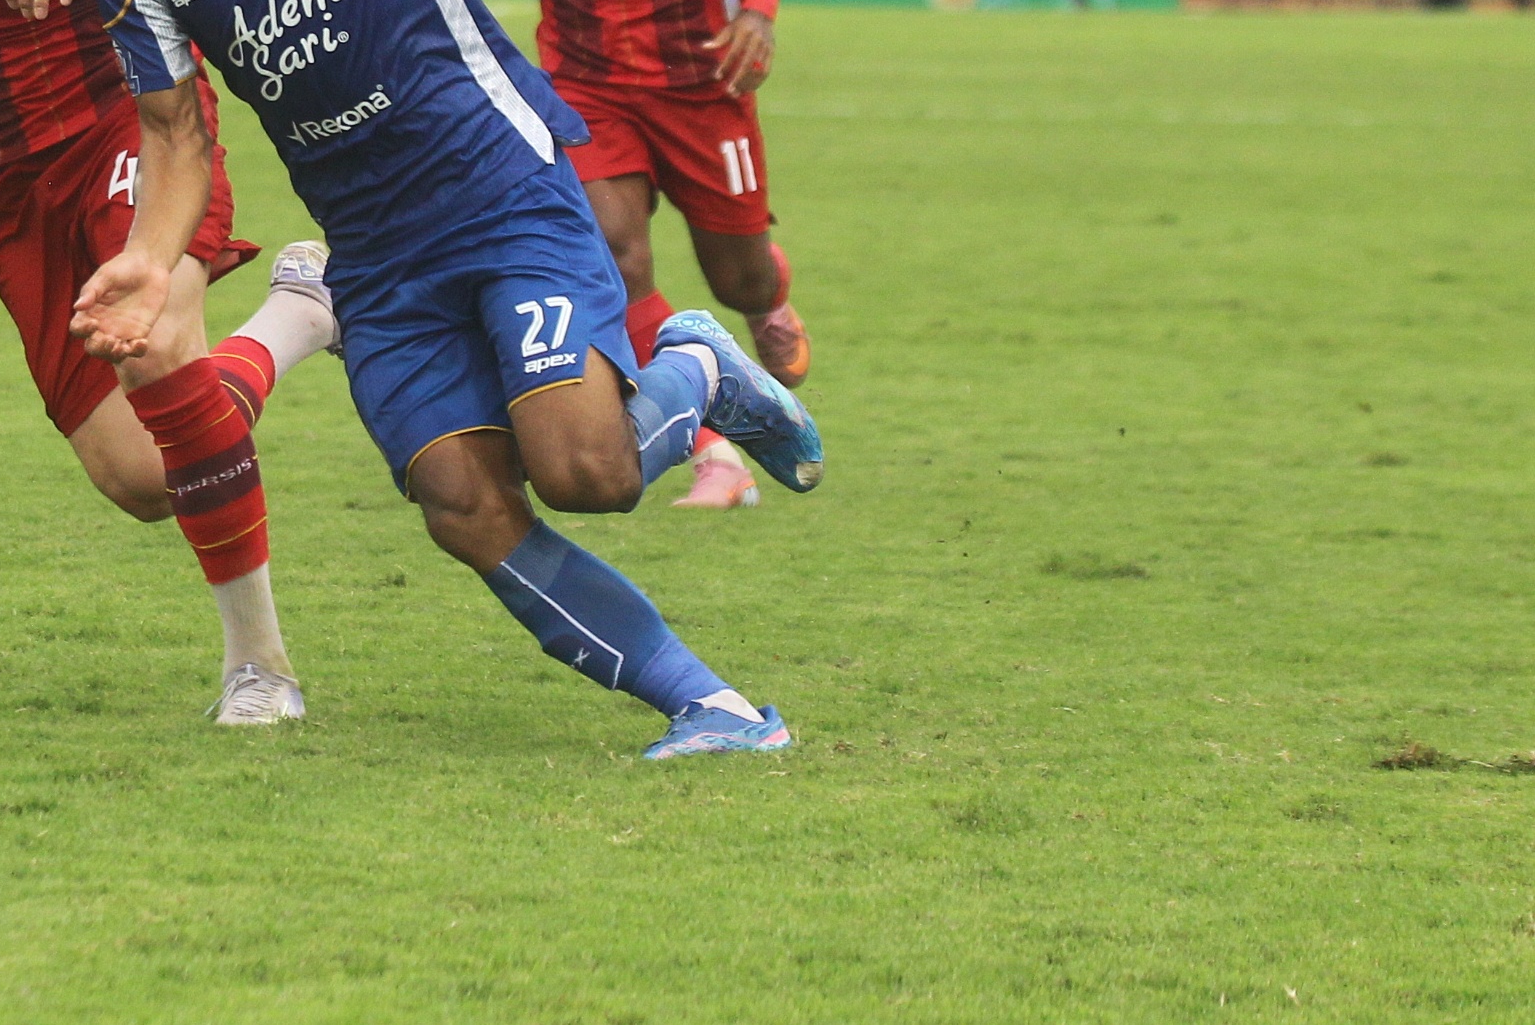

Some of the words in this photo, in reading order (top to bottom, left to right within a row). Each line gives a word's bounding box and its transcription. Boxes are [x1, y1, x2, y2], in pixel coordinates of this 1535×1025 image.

[252, 12, 339, 102] Sari
[299, 91, 392, 141] Rexona
[720, 138, 758, 196] 11
[515, 296, 574, 358] 27
[524, 353, 578, 374] apex
[177, 458, 252, 496] PERSIS
